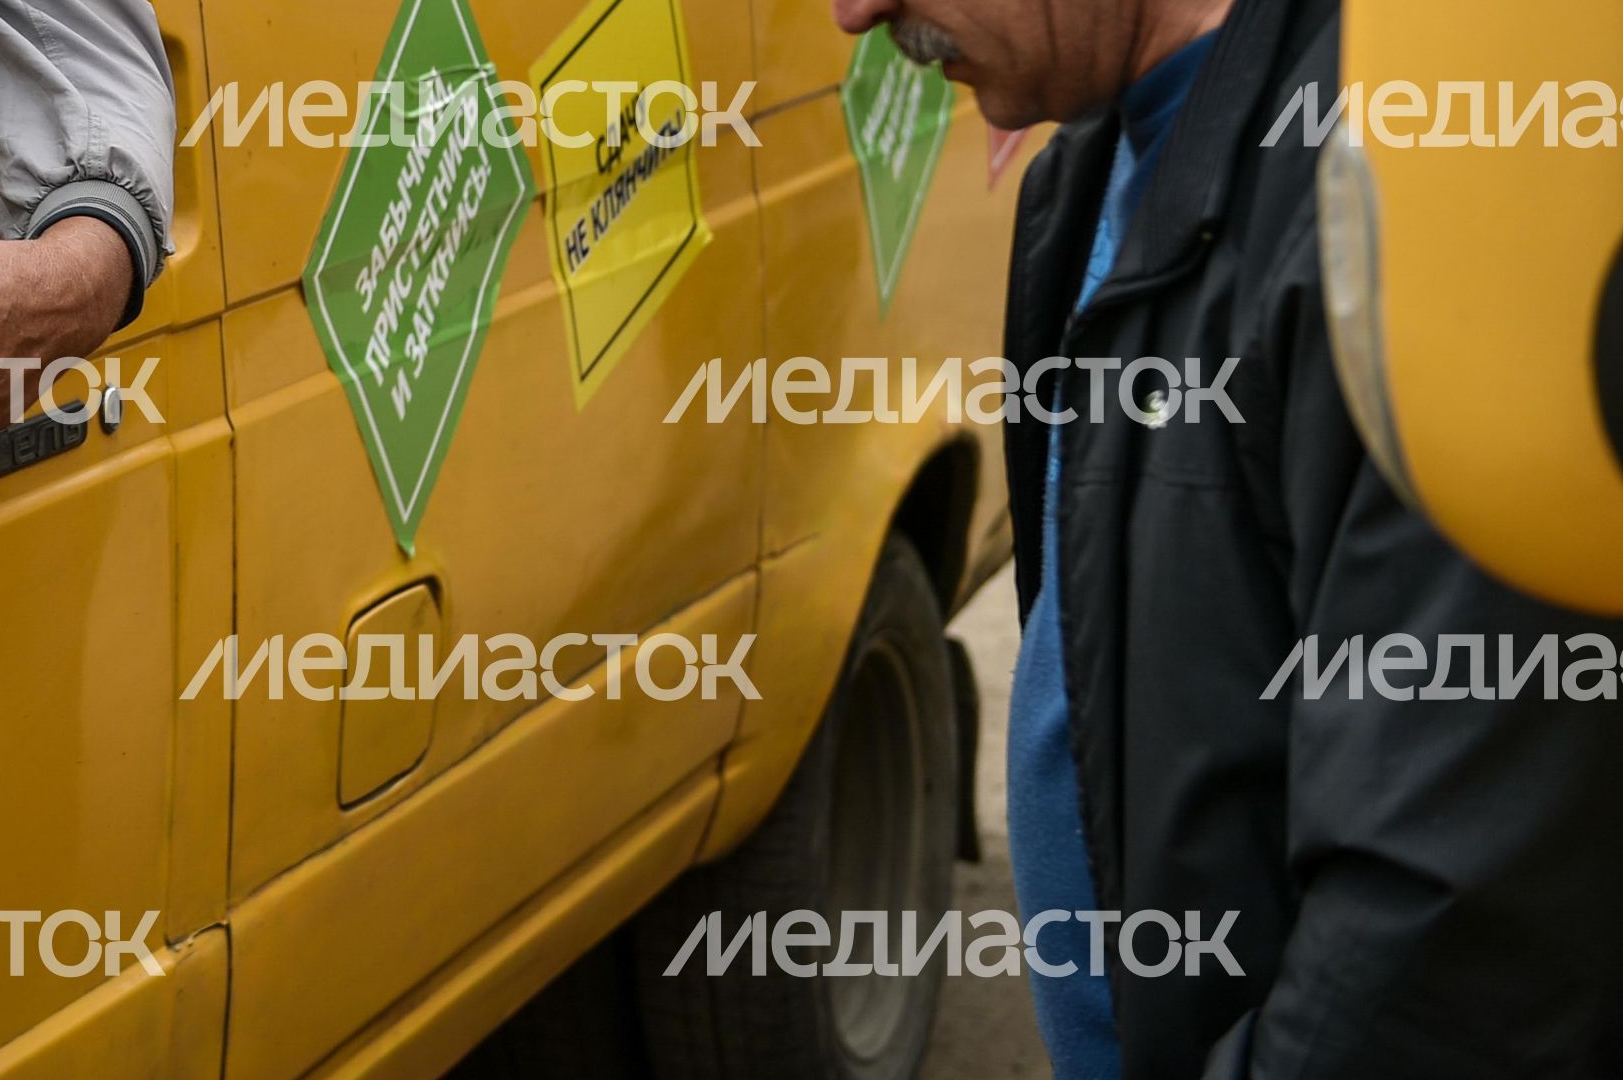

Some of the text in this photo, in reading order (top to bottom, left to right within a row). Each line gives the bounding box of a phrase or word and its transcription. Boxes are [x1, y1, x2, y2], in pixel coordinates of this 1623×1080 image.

[596, 85, 647, 175] СДАЧУ
[365, 95, 479, 387] ПРИСТЕГНИСЬ
[391, 141, 491, 421] И ЗАТКНИСЬ!
[565, 217, 590, 273] НЕ
